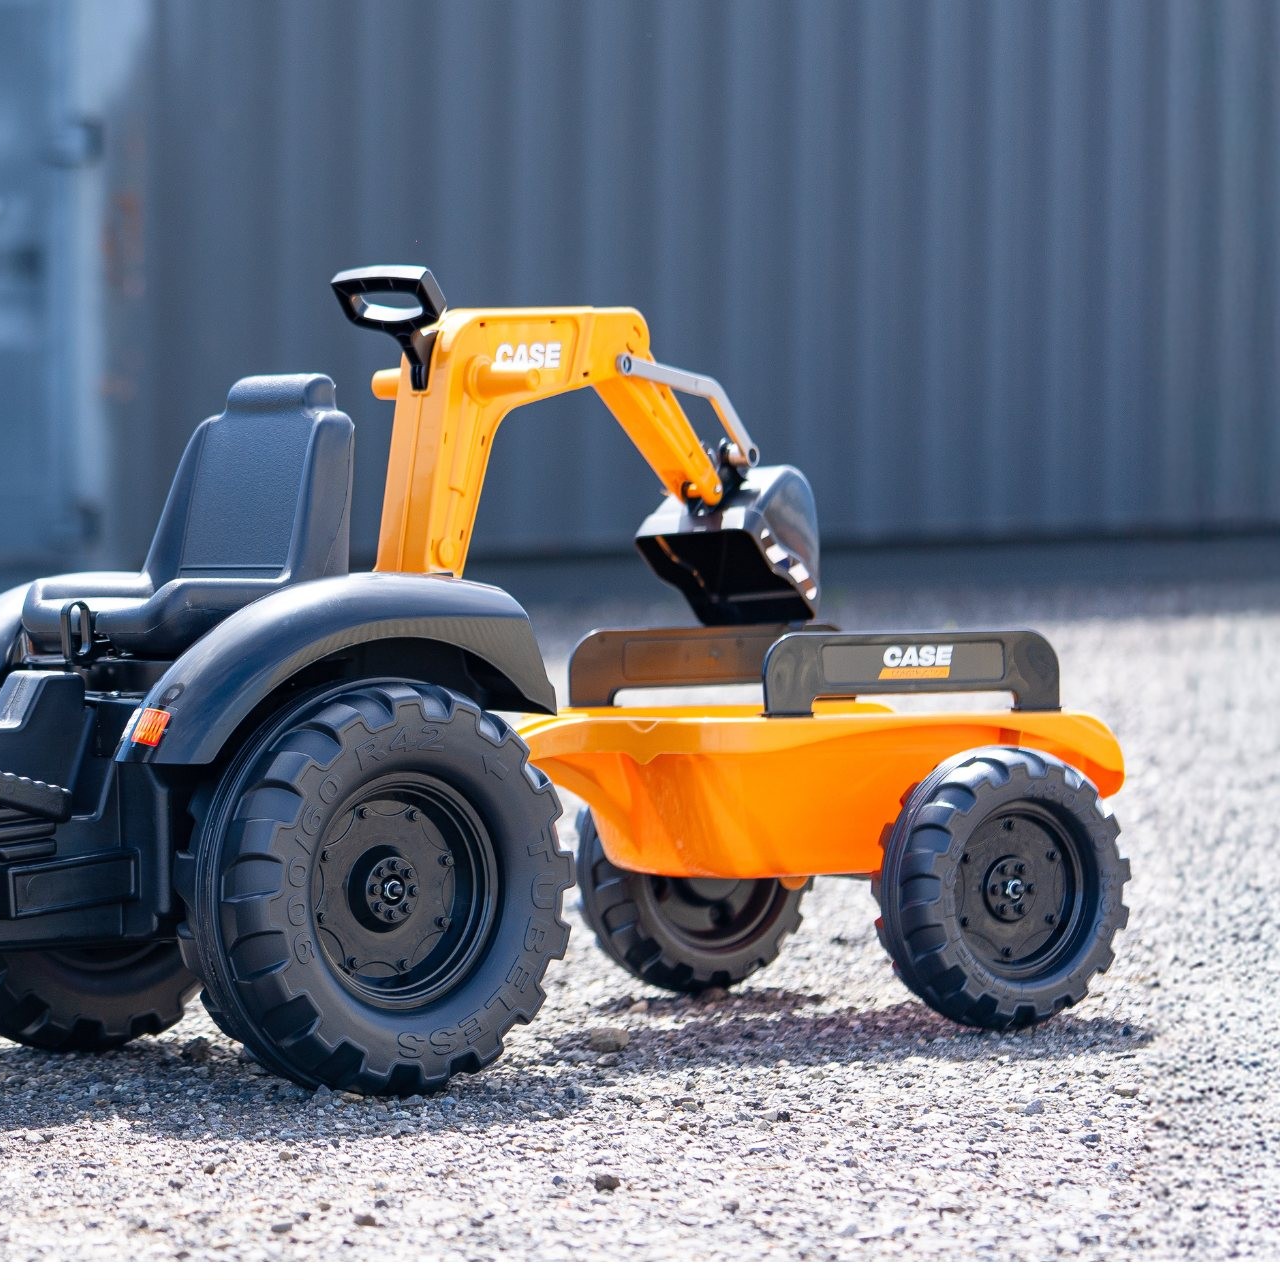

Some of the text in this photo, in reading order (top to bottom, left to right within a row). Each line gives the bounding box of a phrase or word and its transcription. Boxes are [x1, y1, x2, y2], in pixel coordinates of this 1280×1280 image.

[495, 341, 562, 370] CASE
[883, 644, 954, 667] CASE
[355, 724, 446, 771] R42
[397, 828, 554, 1060] TUBELESS
